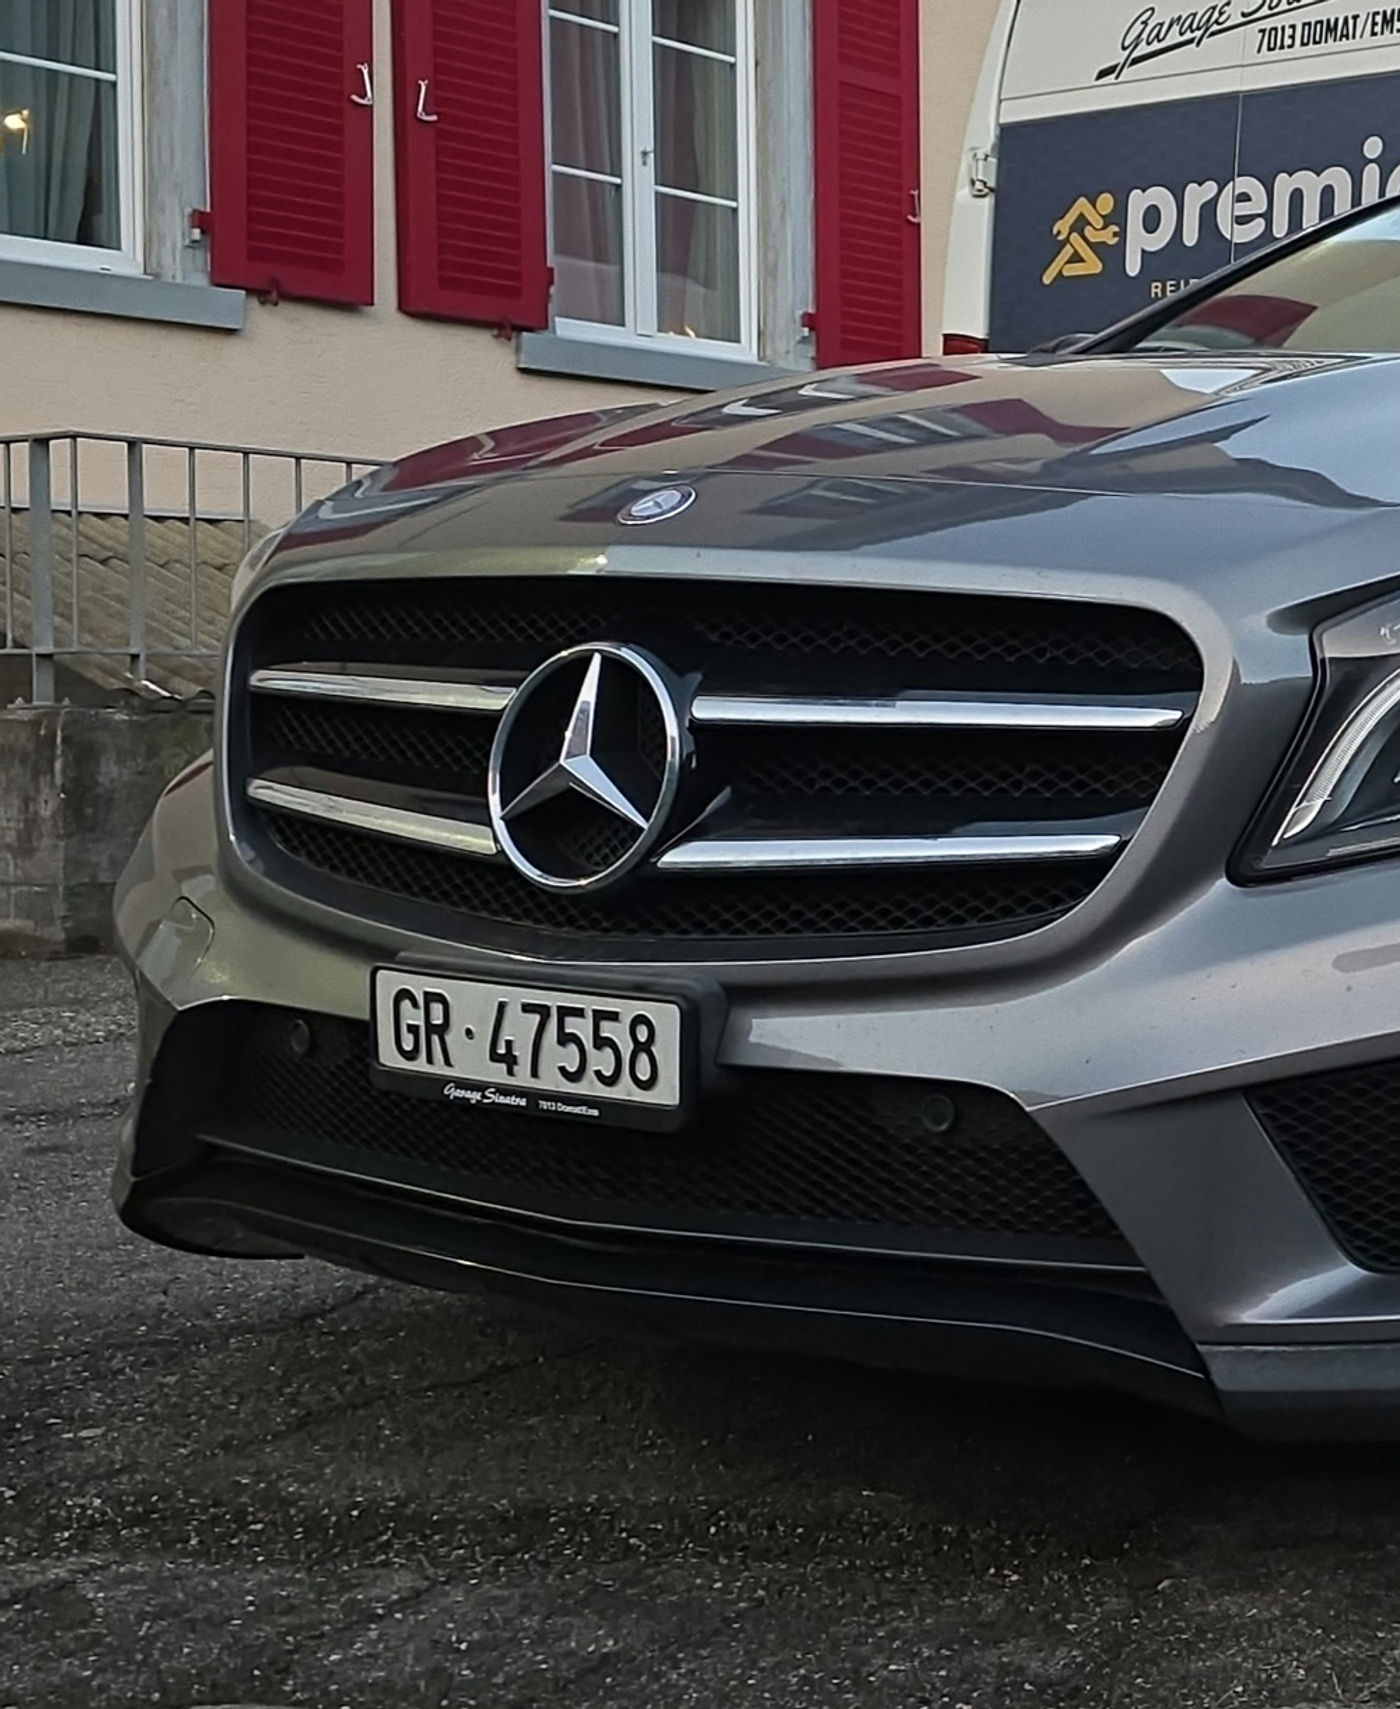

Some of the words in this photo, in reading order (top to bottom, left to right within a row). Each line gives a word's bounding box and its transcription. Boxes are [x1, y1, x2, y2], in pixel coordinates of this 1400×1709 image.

[1113, 0, 1232, 80] Garage
[1256, 24, 1297, 54] 7013
[392, 987, 454, 1068] GR
[488, 998, 660, 1092] 47558
[443, 1083, 482, 1104] Garage
